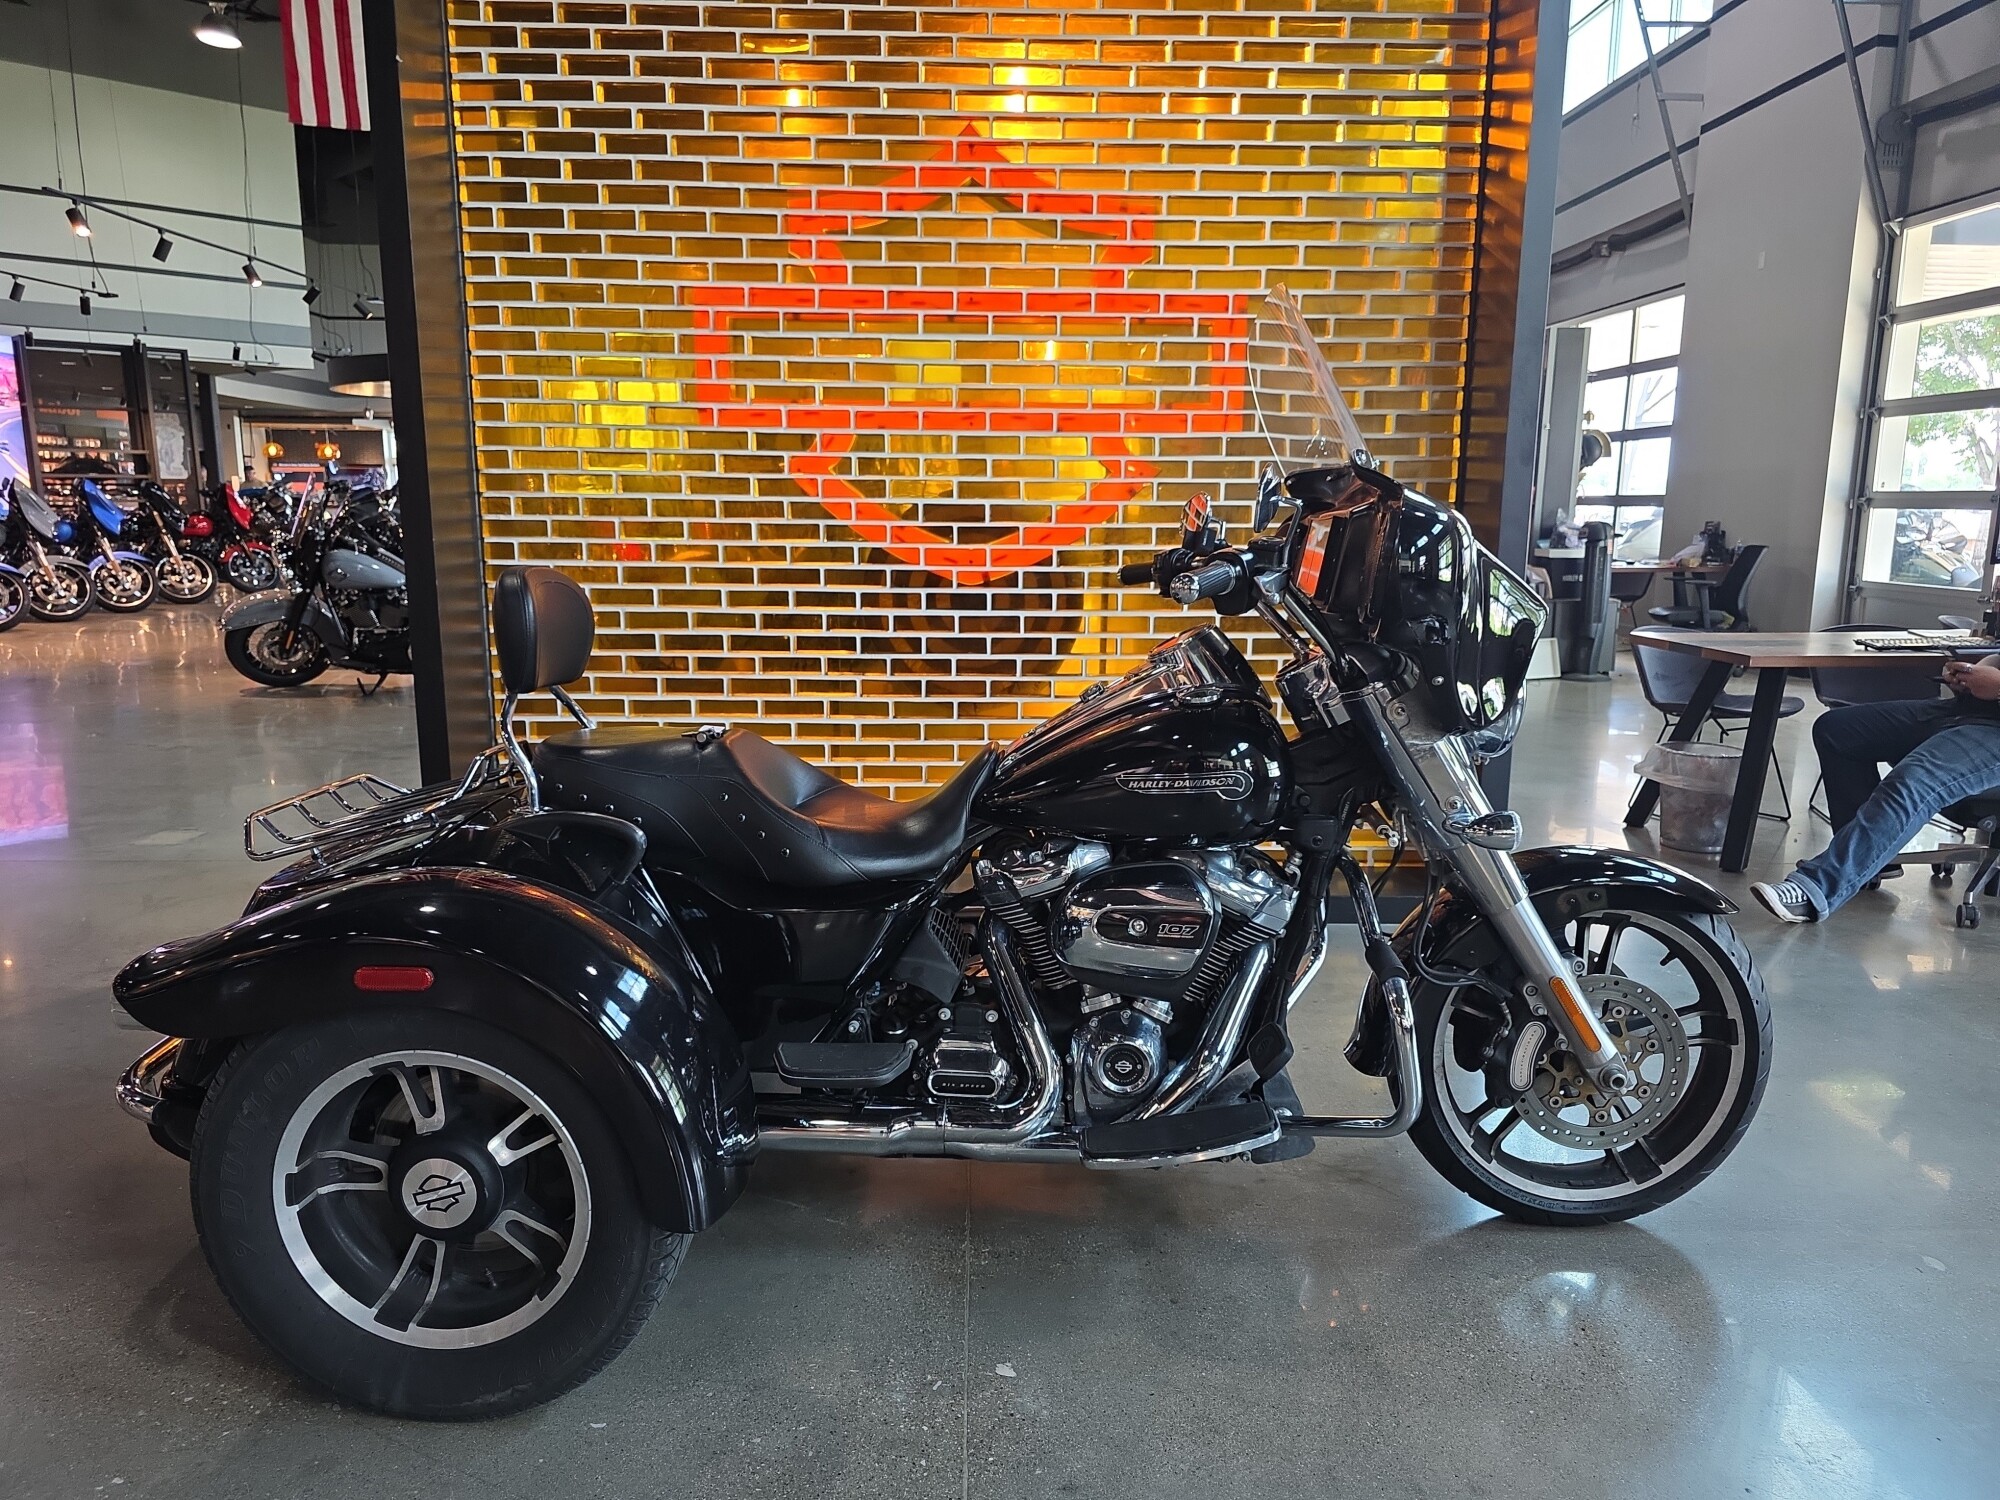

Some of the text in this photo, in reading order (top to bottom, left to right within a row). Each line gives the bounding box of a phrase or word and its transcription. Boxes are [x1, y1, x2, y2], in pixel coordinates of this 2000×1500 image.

[1128, 776, 1235, 789] HARLEY-DAVIDSON
[1158, 923, 1200, 936] 107
[219, 1036, 322, 1224] DUNLOP
